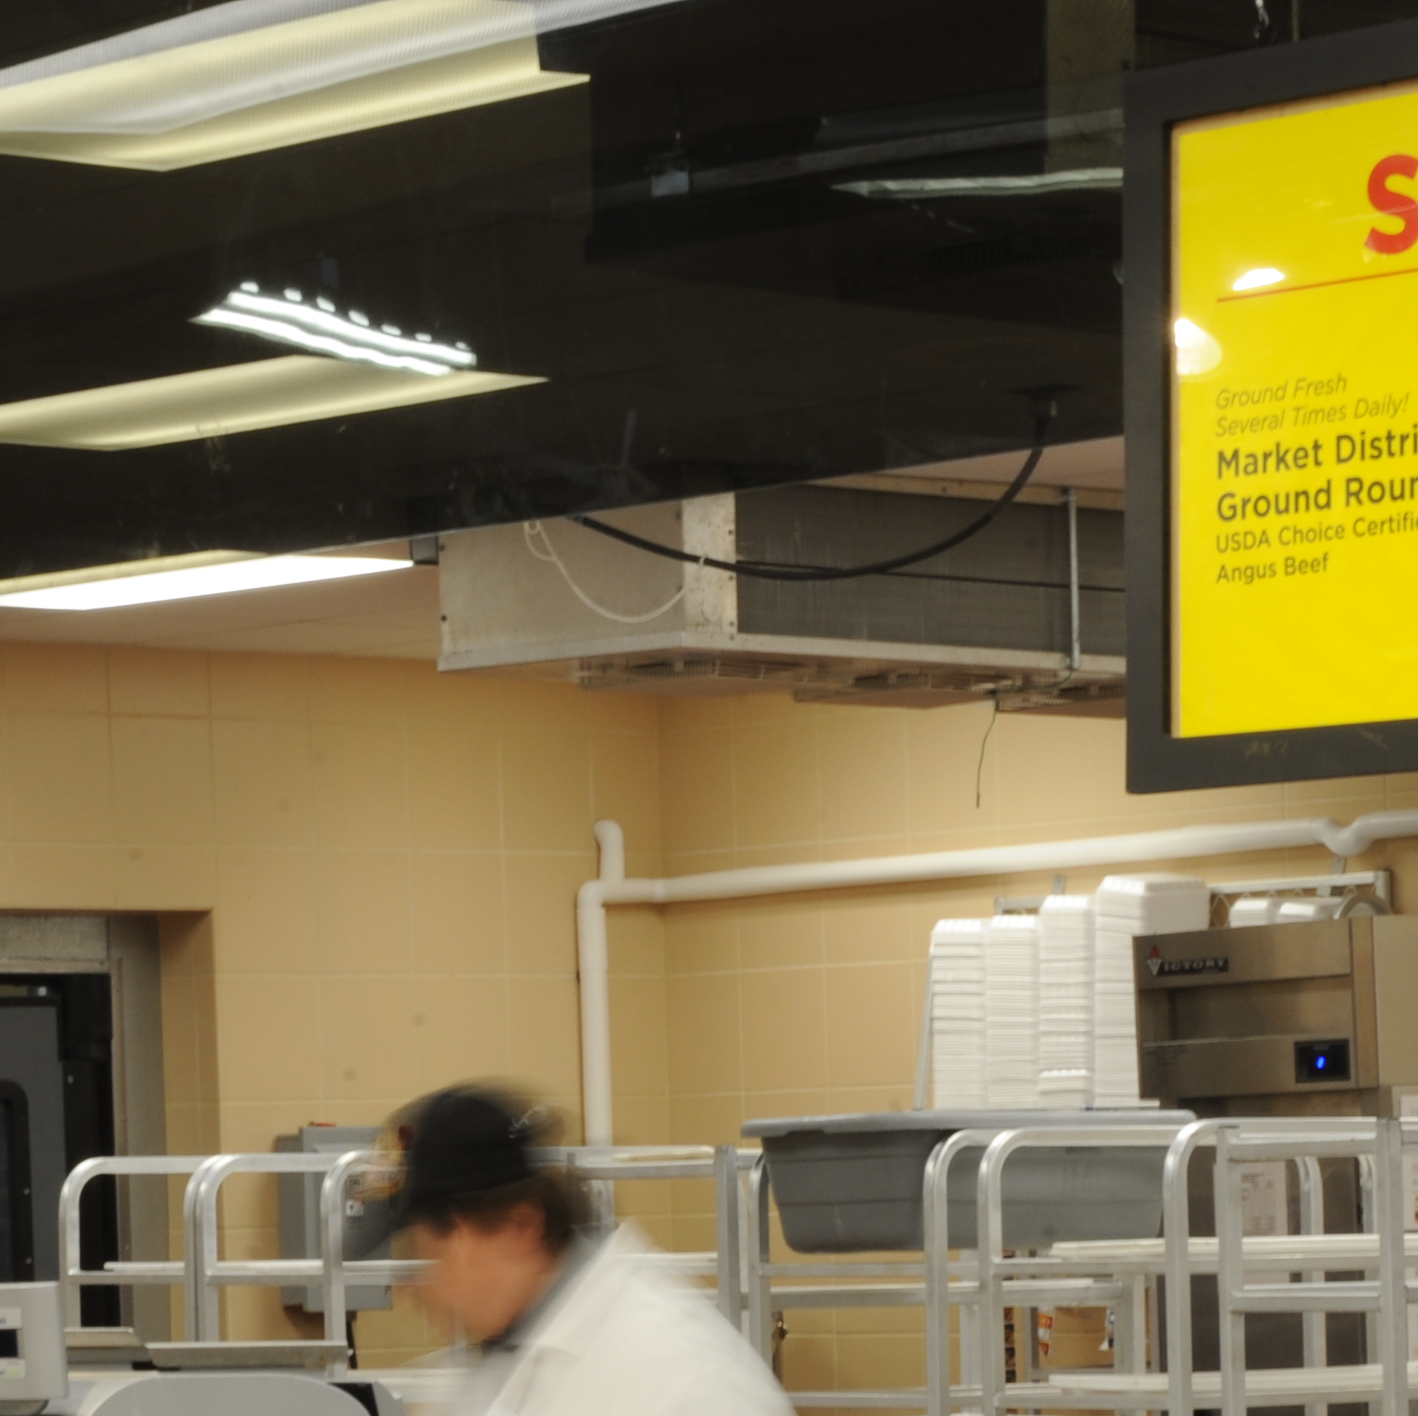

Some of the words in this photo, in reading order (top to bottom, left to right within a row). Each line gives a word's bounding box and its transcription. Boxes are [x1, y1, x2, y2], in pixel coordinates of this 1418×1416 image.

[1215, 380, 1288, 410] Ground
[1293, 373, 1348, 399] Fresh
[1215, 409, 1286, 438] Several
[1293, 405, 1347, 427] Times
[1353, 392, 1410, 420] Daily!
[1217, 439, 1323, 480] Market
[1217, 479, 1332, 522] Ground
[1216, 530, 1271, 554] USDA
[1278, 522, 1346, 546] Choice
[1216, 562, 1277, 585] Angus
[1284, 551, 1329, 577] Beef
